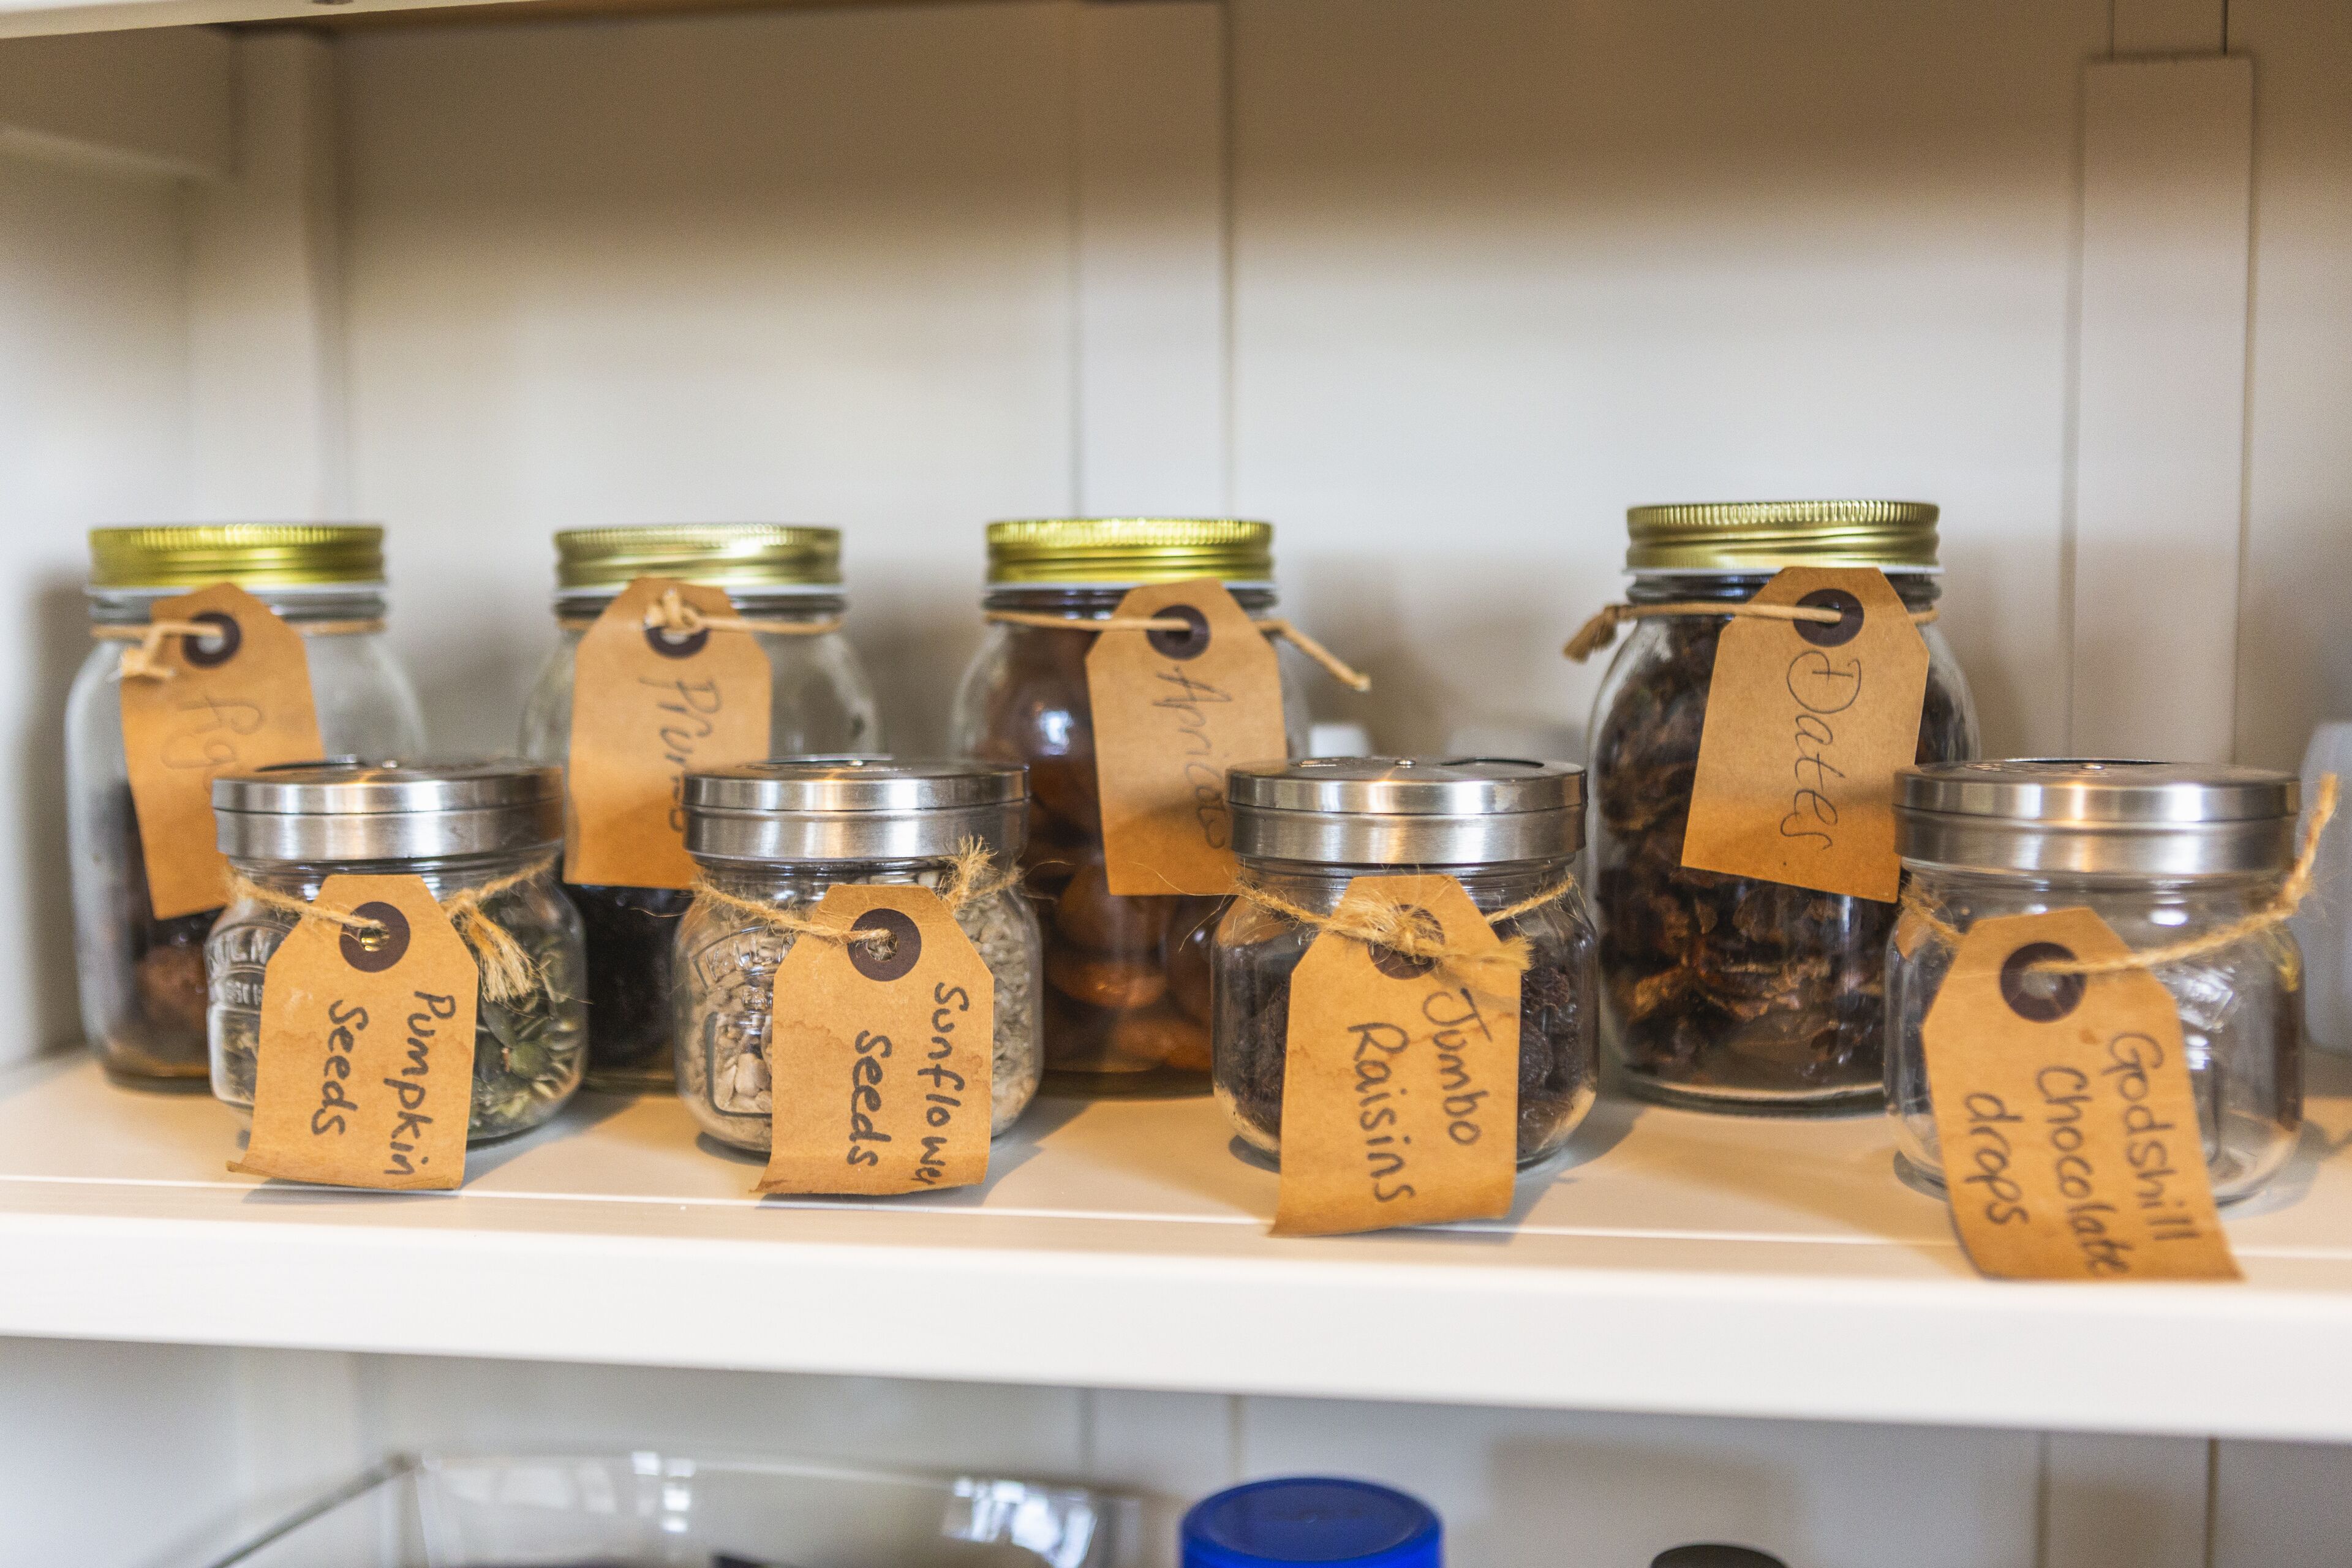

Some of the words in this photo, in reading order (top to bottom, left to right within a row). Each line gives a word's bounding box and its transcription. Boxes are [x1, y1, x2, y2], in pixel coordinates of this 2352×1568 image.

[639, 677, 723, 834] Prun
[311, 999, 369, 1136] Seeds
[383, 990, 456, 1175] Pumpkin
[846, 1030, 892, 1166] Seeds
[1349, 1022, 1416, 1202] Raisins
[1422, 989, 1493, 1145] Jumbo
[2101, 1031, 2200, 1241] Godshill
[1965, 1091, 2029, 1226] drops
[2035, 1065, 2136, 1276] Chocolate
